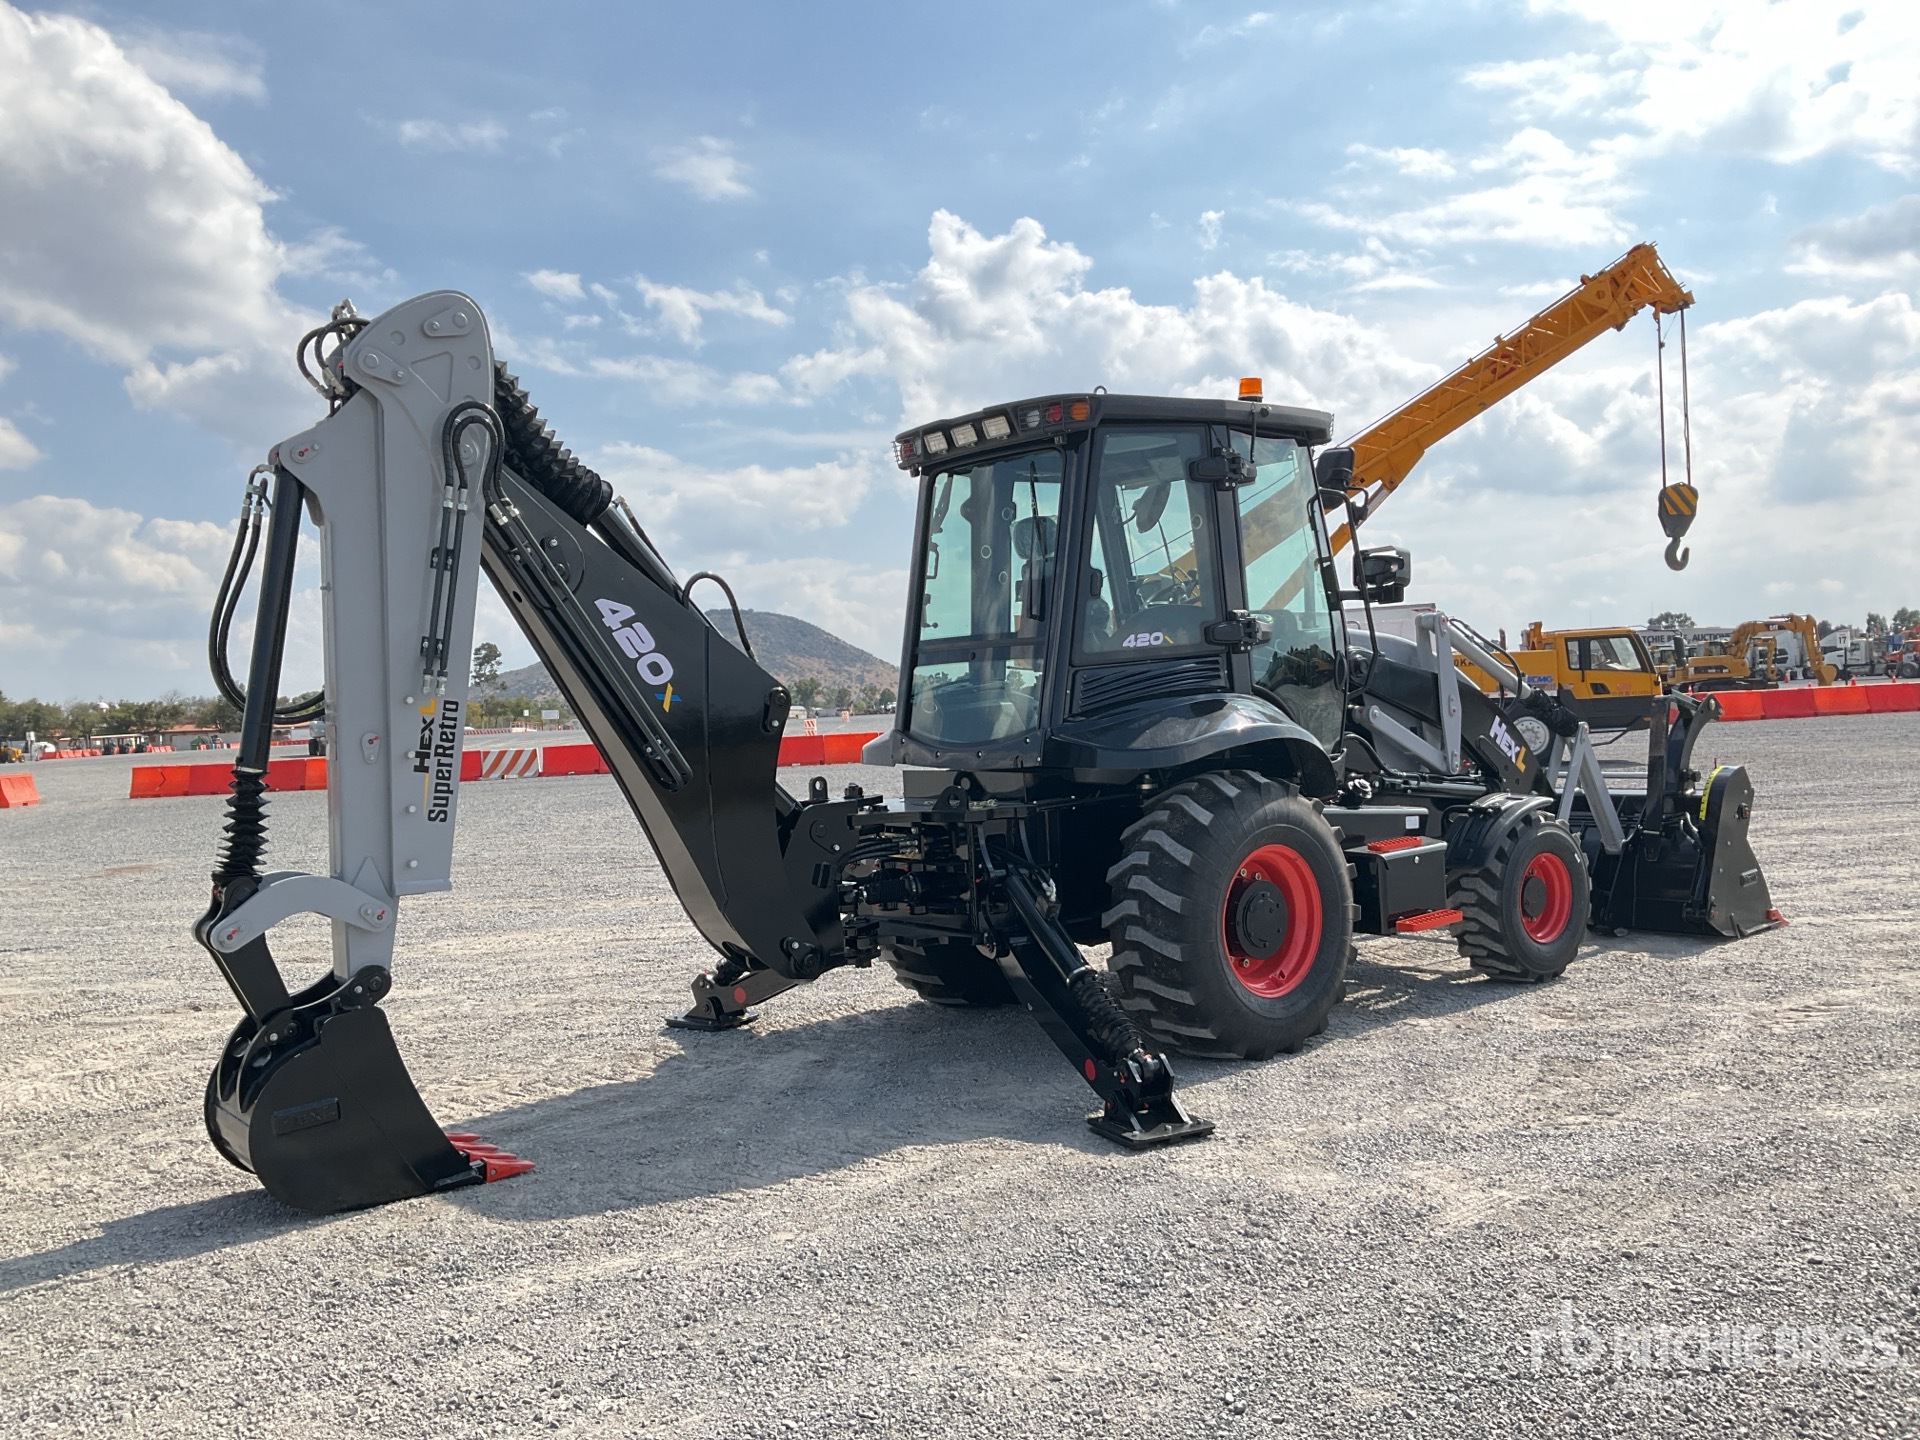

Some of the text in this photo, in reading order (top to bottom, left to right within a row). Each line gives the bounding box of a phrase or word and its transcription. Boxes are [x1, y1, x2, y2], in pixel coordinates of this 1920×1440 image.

[1641, 635, 1665, 643] TCHIE
[1838, 636, 1847, 644] 17
[428, 700, 459, 823] SuperRetro
